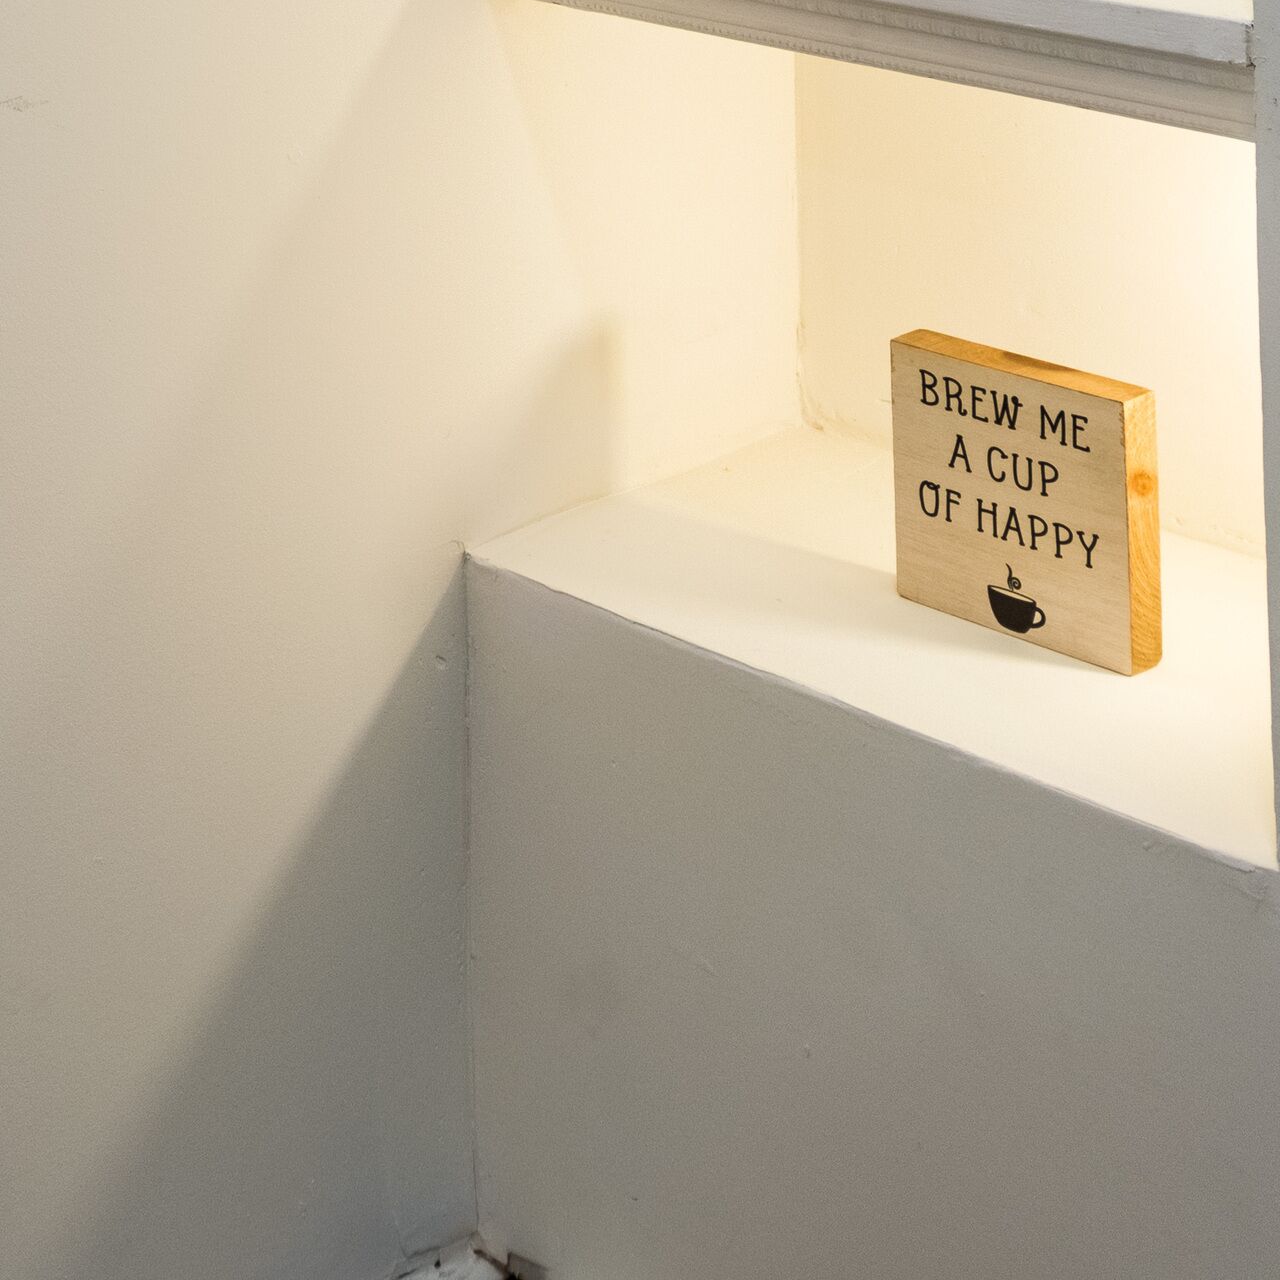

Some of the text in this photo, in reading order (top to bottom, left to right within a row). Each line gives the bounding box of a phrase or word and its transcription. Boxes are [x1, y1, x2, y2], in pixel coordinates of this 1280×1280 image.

[919, 368, 1091, 453] BREW ME
[948, 434, 1059, 497] A CUP
[919, 480, 1100, 569] OF HAPPY
